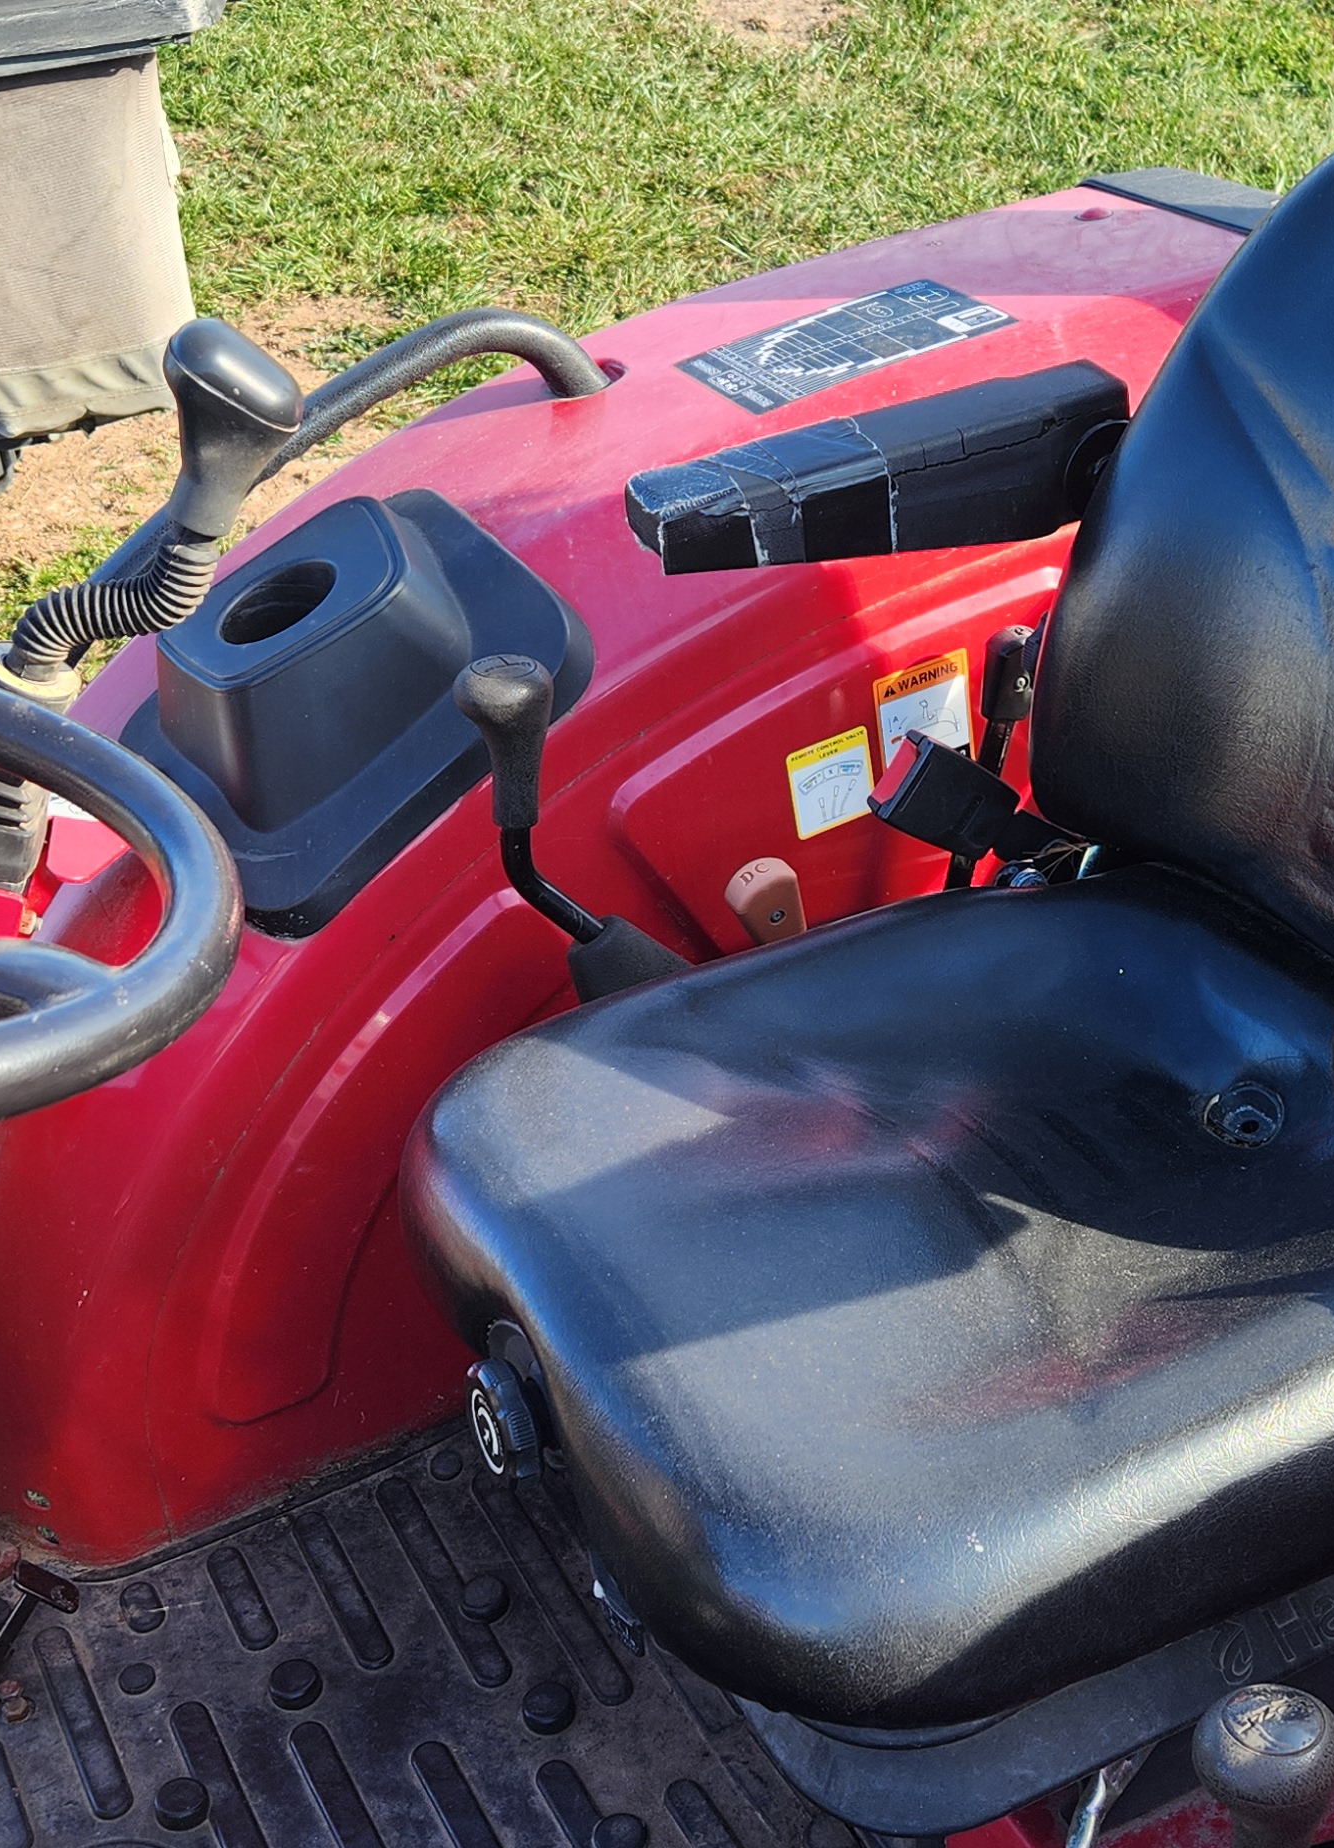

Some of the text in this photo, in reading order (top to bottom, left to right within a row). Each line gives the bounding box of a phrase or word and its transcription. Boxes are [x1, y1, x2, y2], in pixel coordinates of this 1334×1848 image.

[897, 662, 958, 692] WARNING
[790, 729, 865, 762] REMOTE CONTROL VALVE
[819, 748, 839, 759] LEVER
